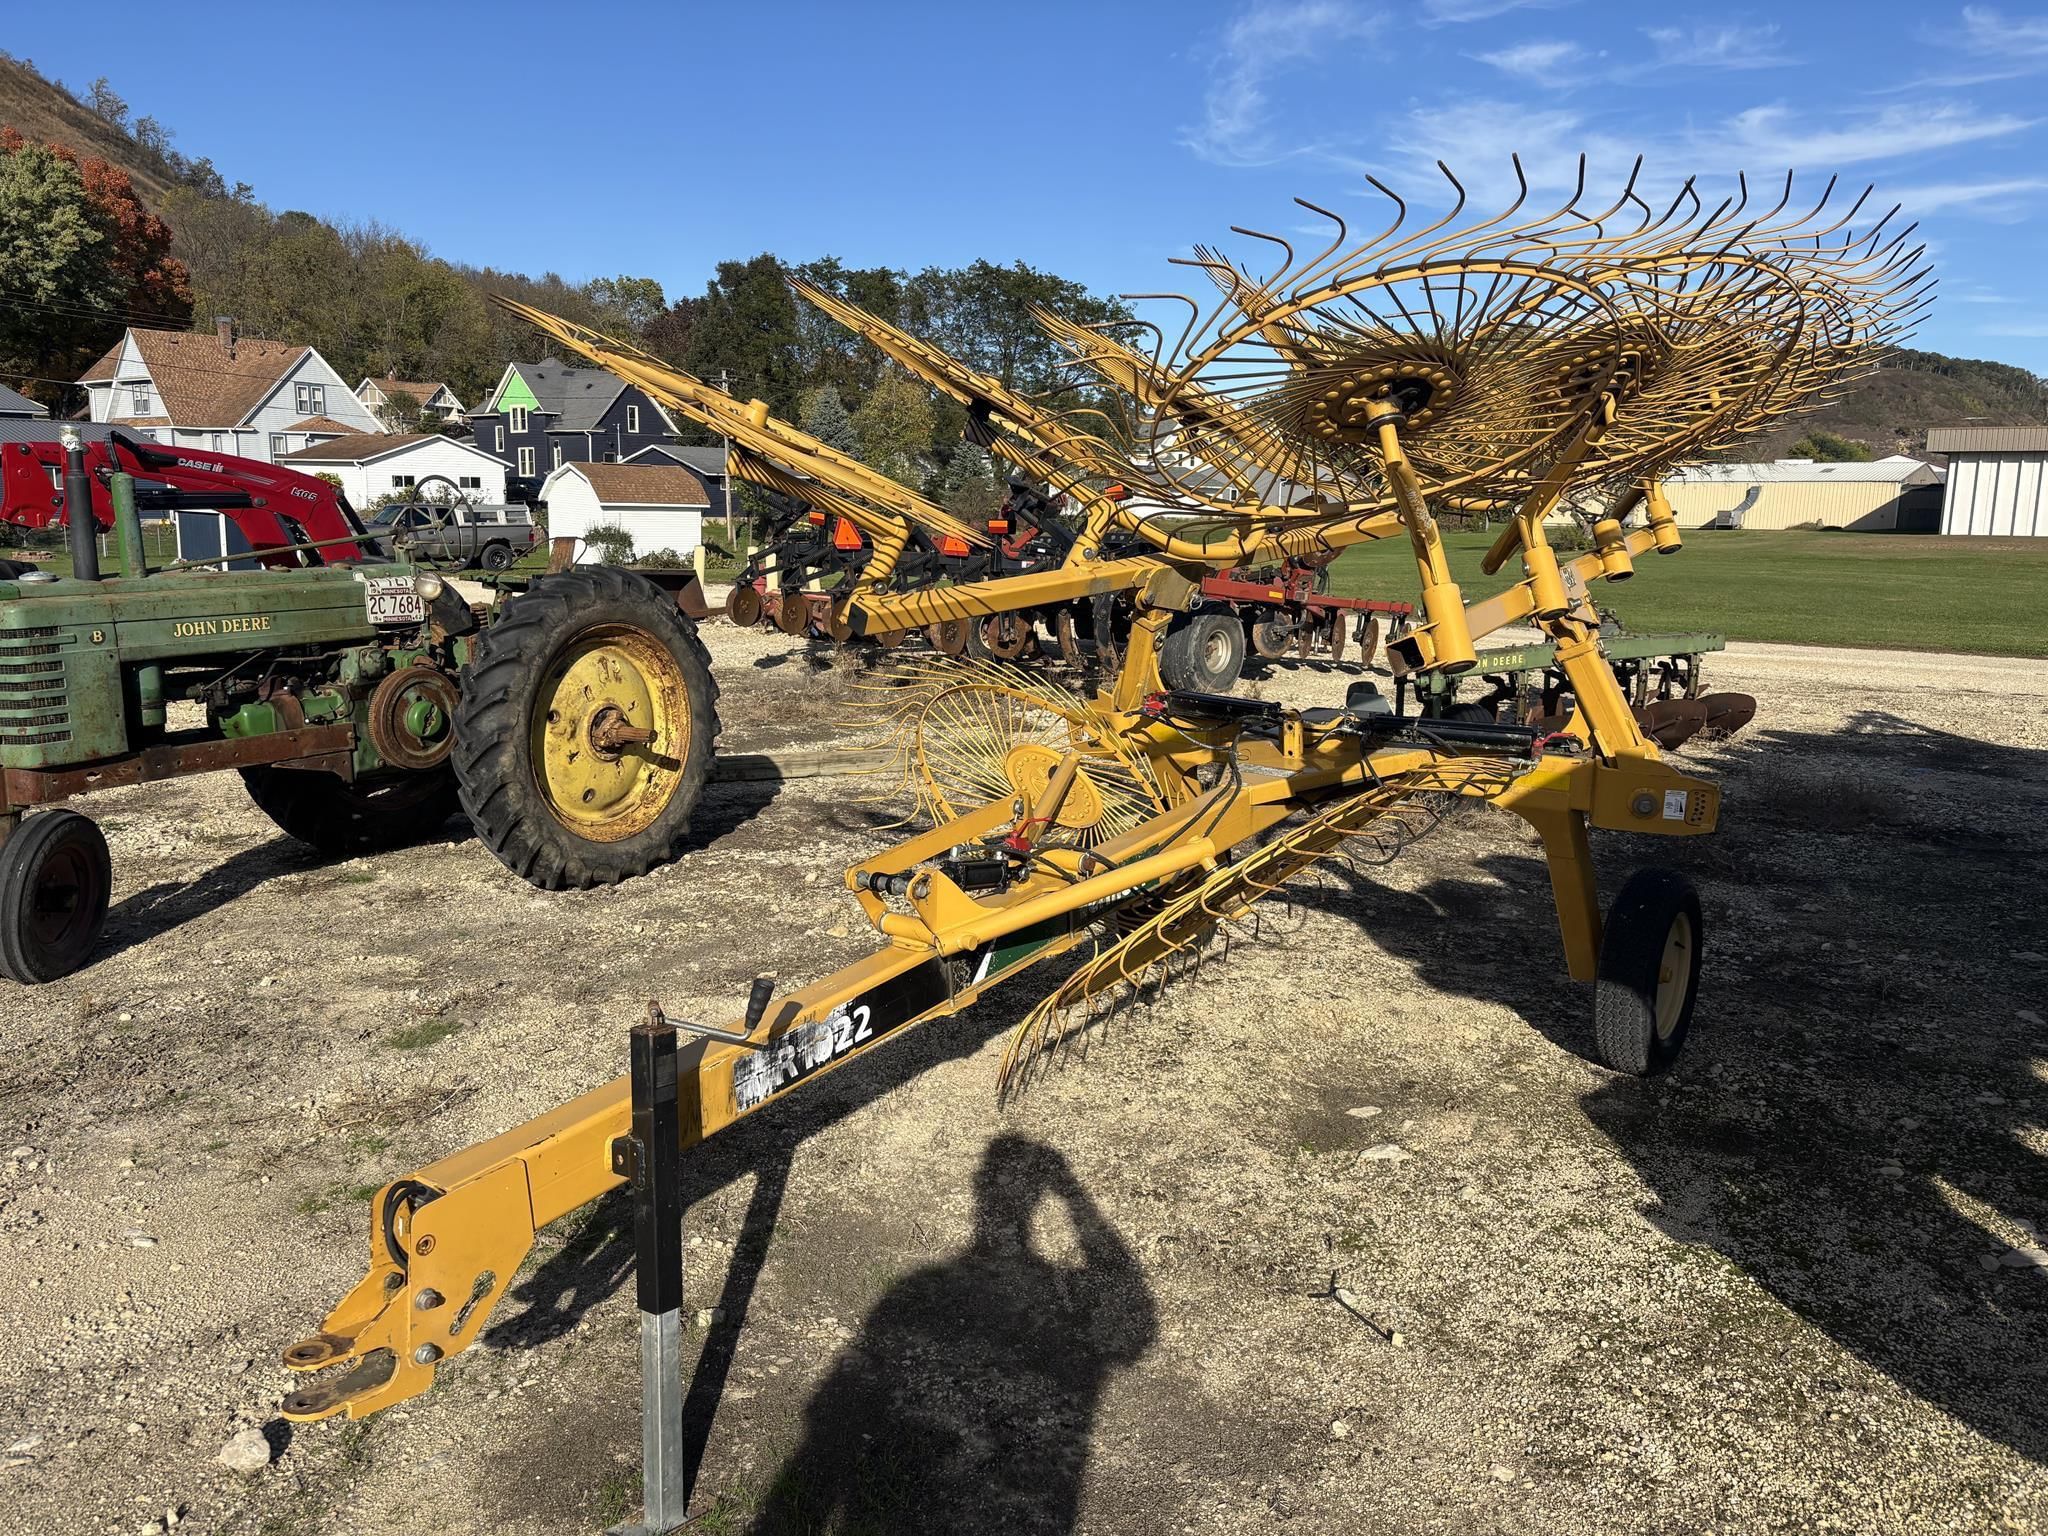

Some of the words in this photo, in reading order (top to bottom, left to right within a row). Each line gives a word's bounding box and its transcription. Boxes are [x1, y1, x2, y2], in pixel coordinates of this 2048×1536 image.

[177, 458, 211, 471] CASE
[369, 596, 386, 615] 2C
[390, 595, 422, 614] 7684
[174, 620, 217, 638] JOHN
[222, 616, 271, 634] DEERE
[92, 630, 103, 643] B
[1493, 654, 1524, 667] DEERE
